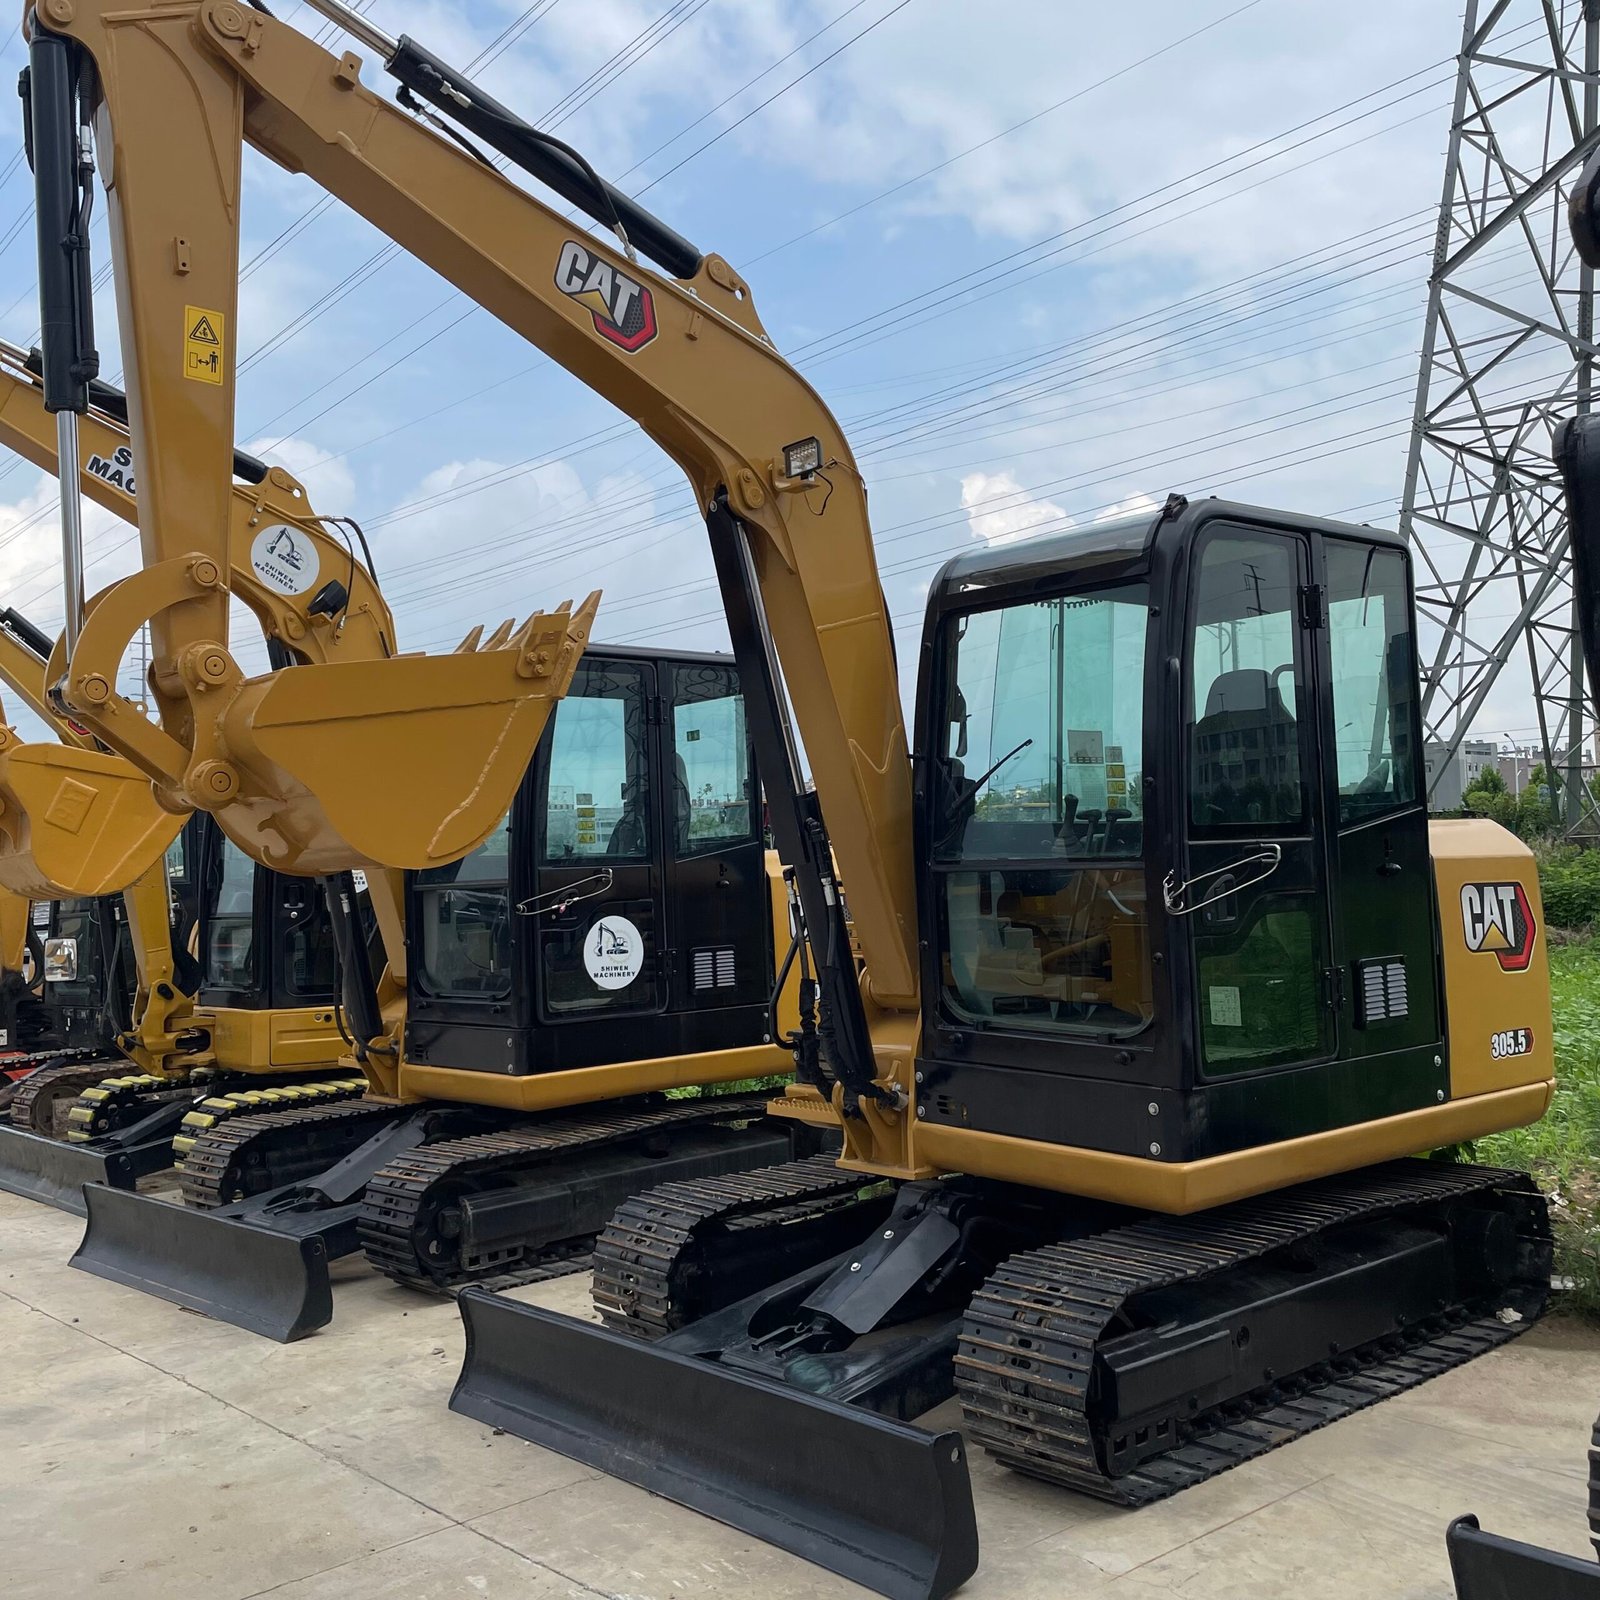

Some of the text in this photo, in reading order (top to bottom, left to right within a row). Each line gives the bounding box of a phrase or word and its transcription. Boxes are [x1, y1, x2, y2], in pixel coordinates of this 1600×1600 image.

[556, 242, 640, 327] CAT
[253, 561, 299, 593] MACHINERY
[264, 562, 294, 583] SHIWEN
[1461, 885, 1516, 950] CAT
[593, 971, 636, 979] MACHINERY
[1491, 1029, 1526, 1058] 305.5
